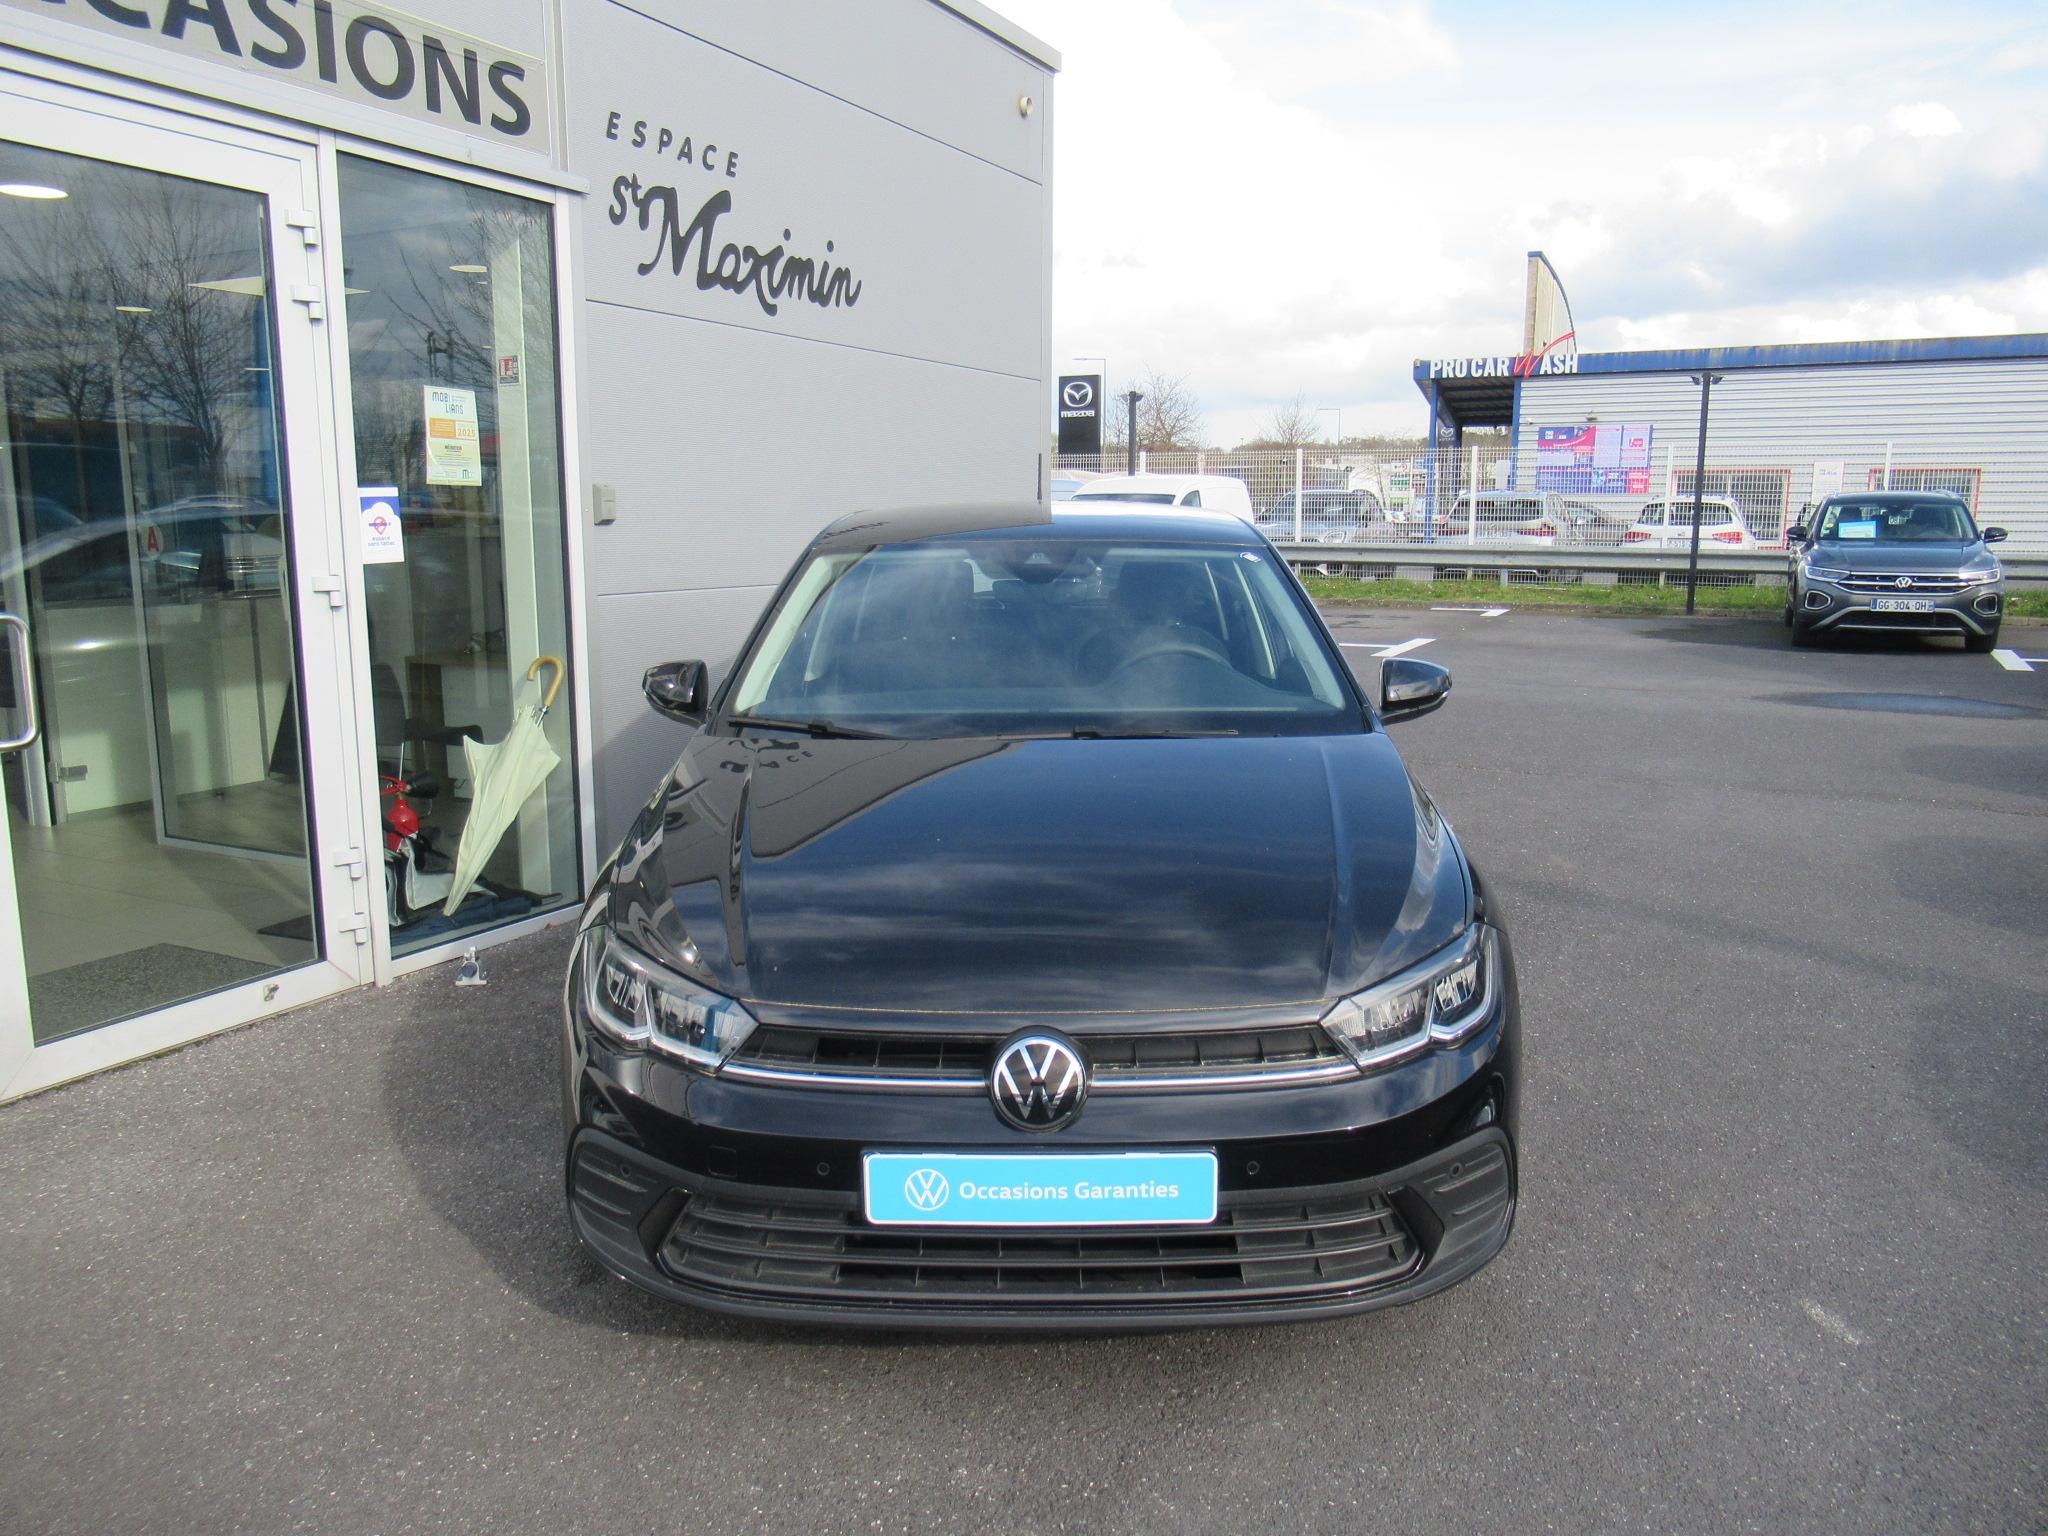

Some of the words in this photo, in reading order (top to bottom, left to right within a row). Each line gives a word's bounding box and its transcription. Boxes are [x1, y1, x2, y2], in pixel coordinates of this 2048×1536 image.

[606, 111, 739, 178] ESPACE
[637, 185, 862, 317] Maximin
[1430, 357, 1467, 379] PRO
[1471, 356, 1509, 378] CAR
[1512, 343, 1578, 379] WASH
[959, 1181, 1068, 1200] Occasions
[1074, 1180, 1179, 1199] Garanties
